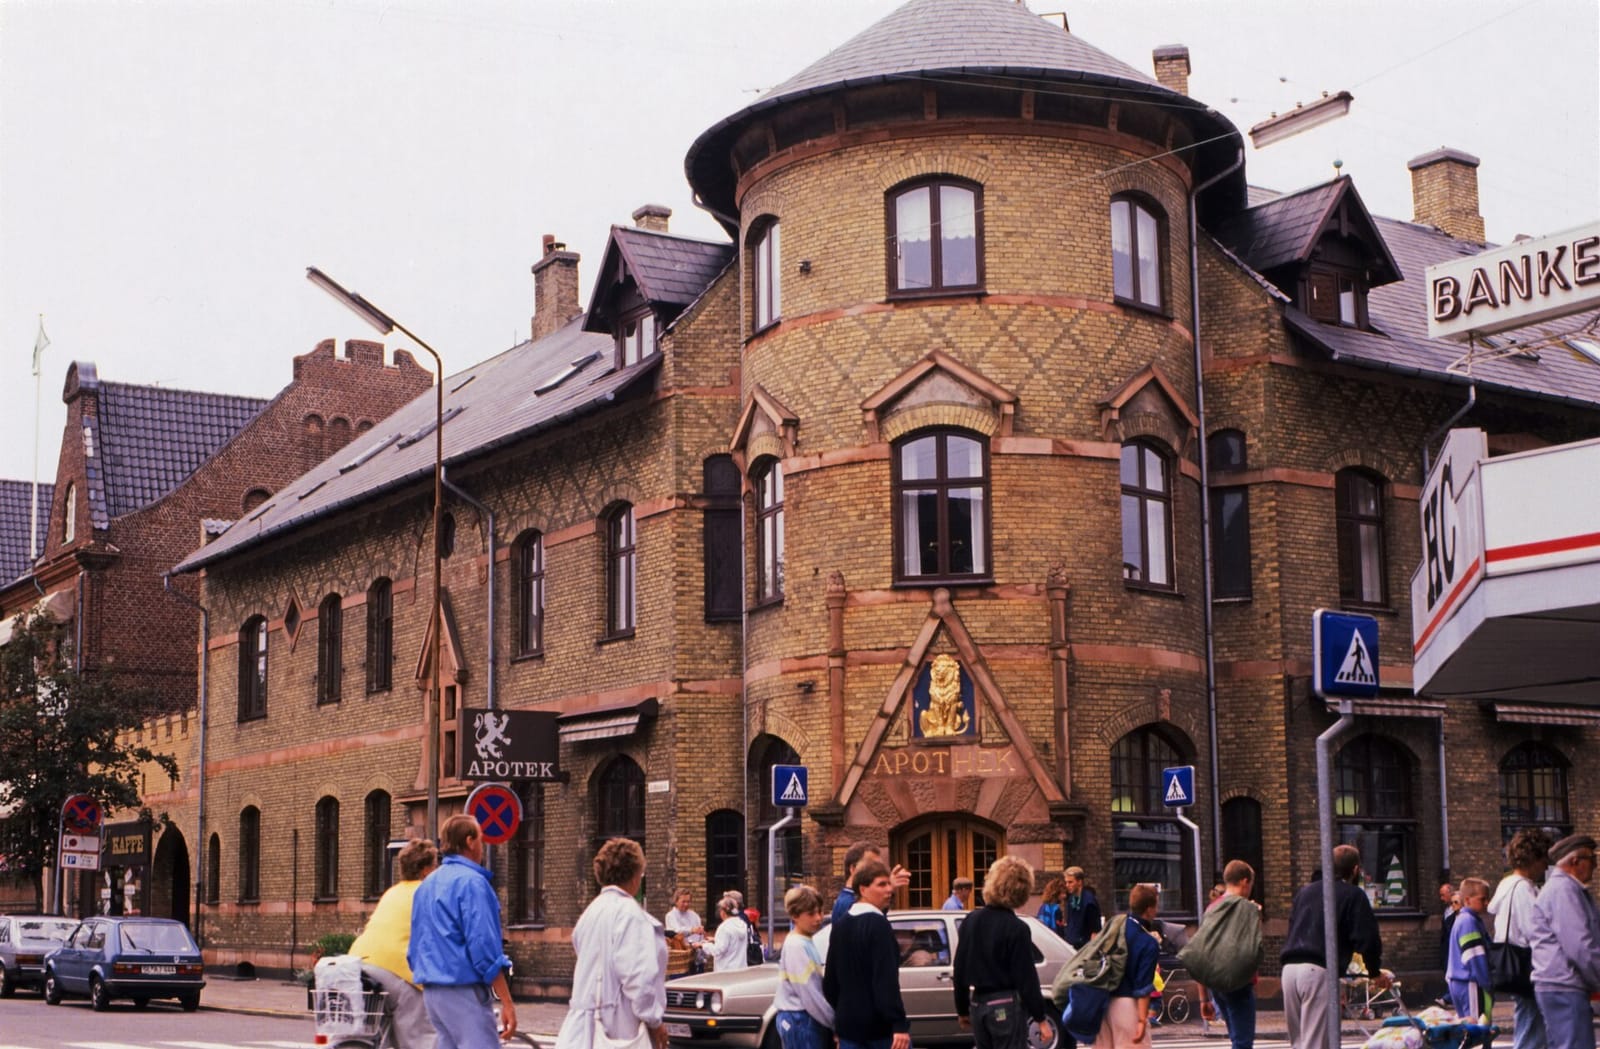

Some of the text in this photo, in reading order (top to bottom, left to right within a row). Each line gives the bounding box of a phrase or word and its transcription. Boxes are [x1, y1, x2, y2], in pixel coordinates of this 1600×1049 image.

[1433, 236, 1600, 321] BANKE
[1424, 456, 1456, 612] HC
[467, 760, 554, 777] APOTEK
[872, 750, 1016, 775] APOTHEK
